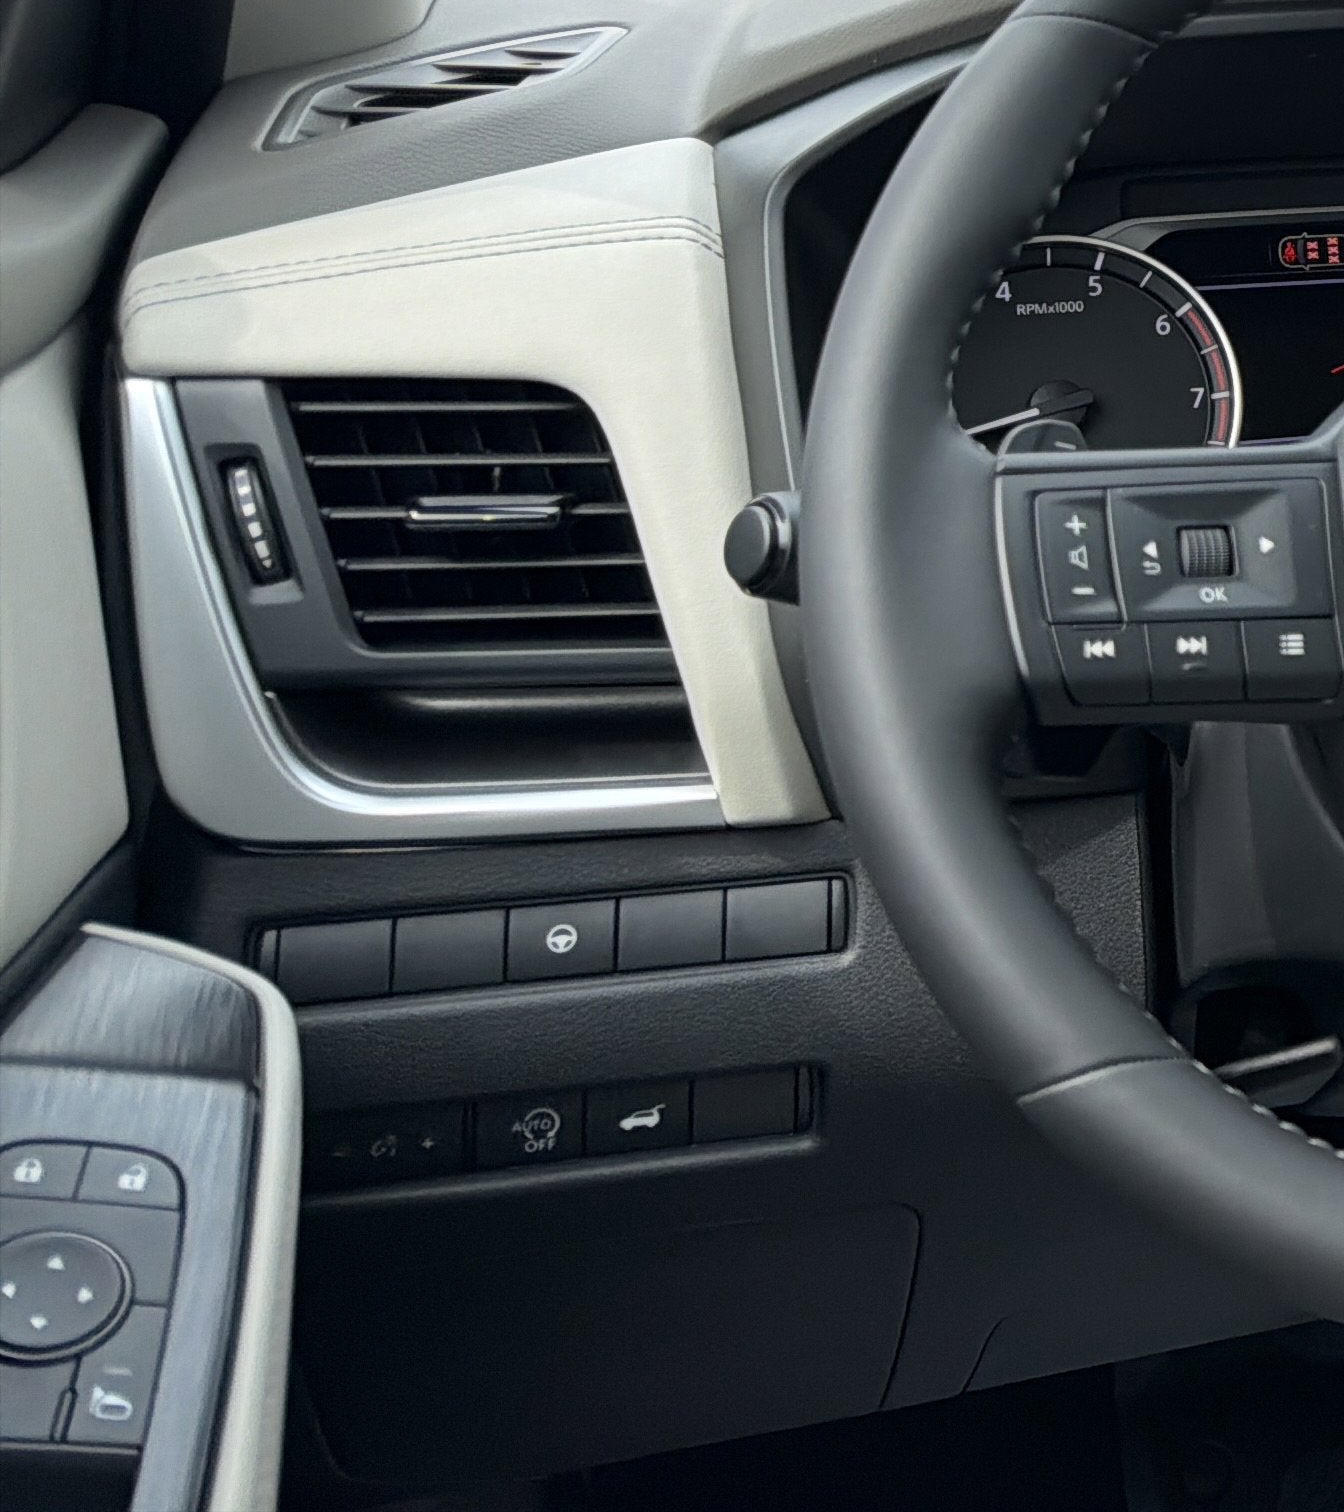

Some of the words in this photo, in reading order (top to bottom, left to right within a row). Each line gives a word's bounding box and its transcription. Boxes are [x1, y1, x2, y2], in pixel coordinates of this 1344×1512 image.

[995, 281, 1012, 302] 4
[1088, 275, 1103, 296] 5
[1016, 300, 1085, 316] RPMx1000
[1155, 314, 1171, 336] 6
[1190, 387, 1205, 409] 7
[1199, 588, 1228, 602] OK
[511, 1118, 552, 1133] AUTO
[524, 1137, 556, 1153] OFF
